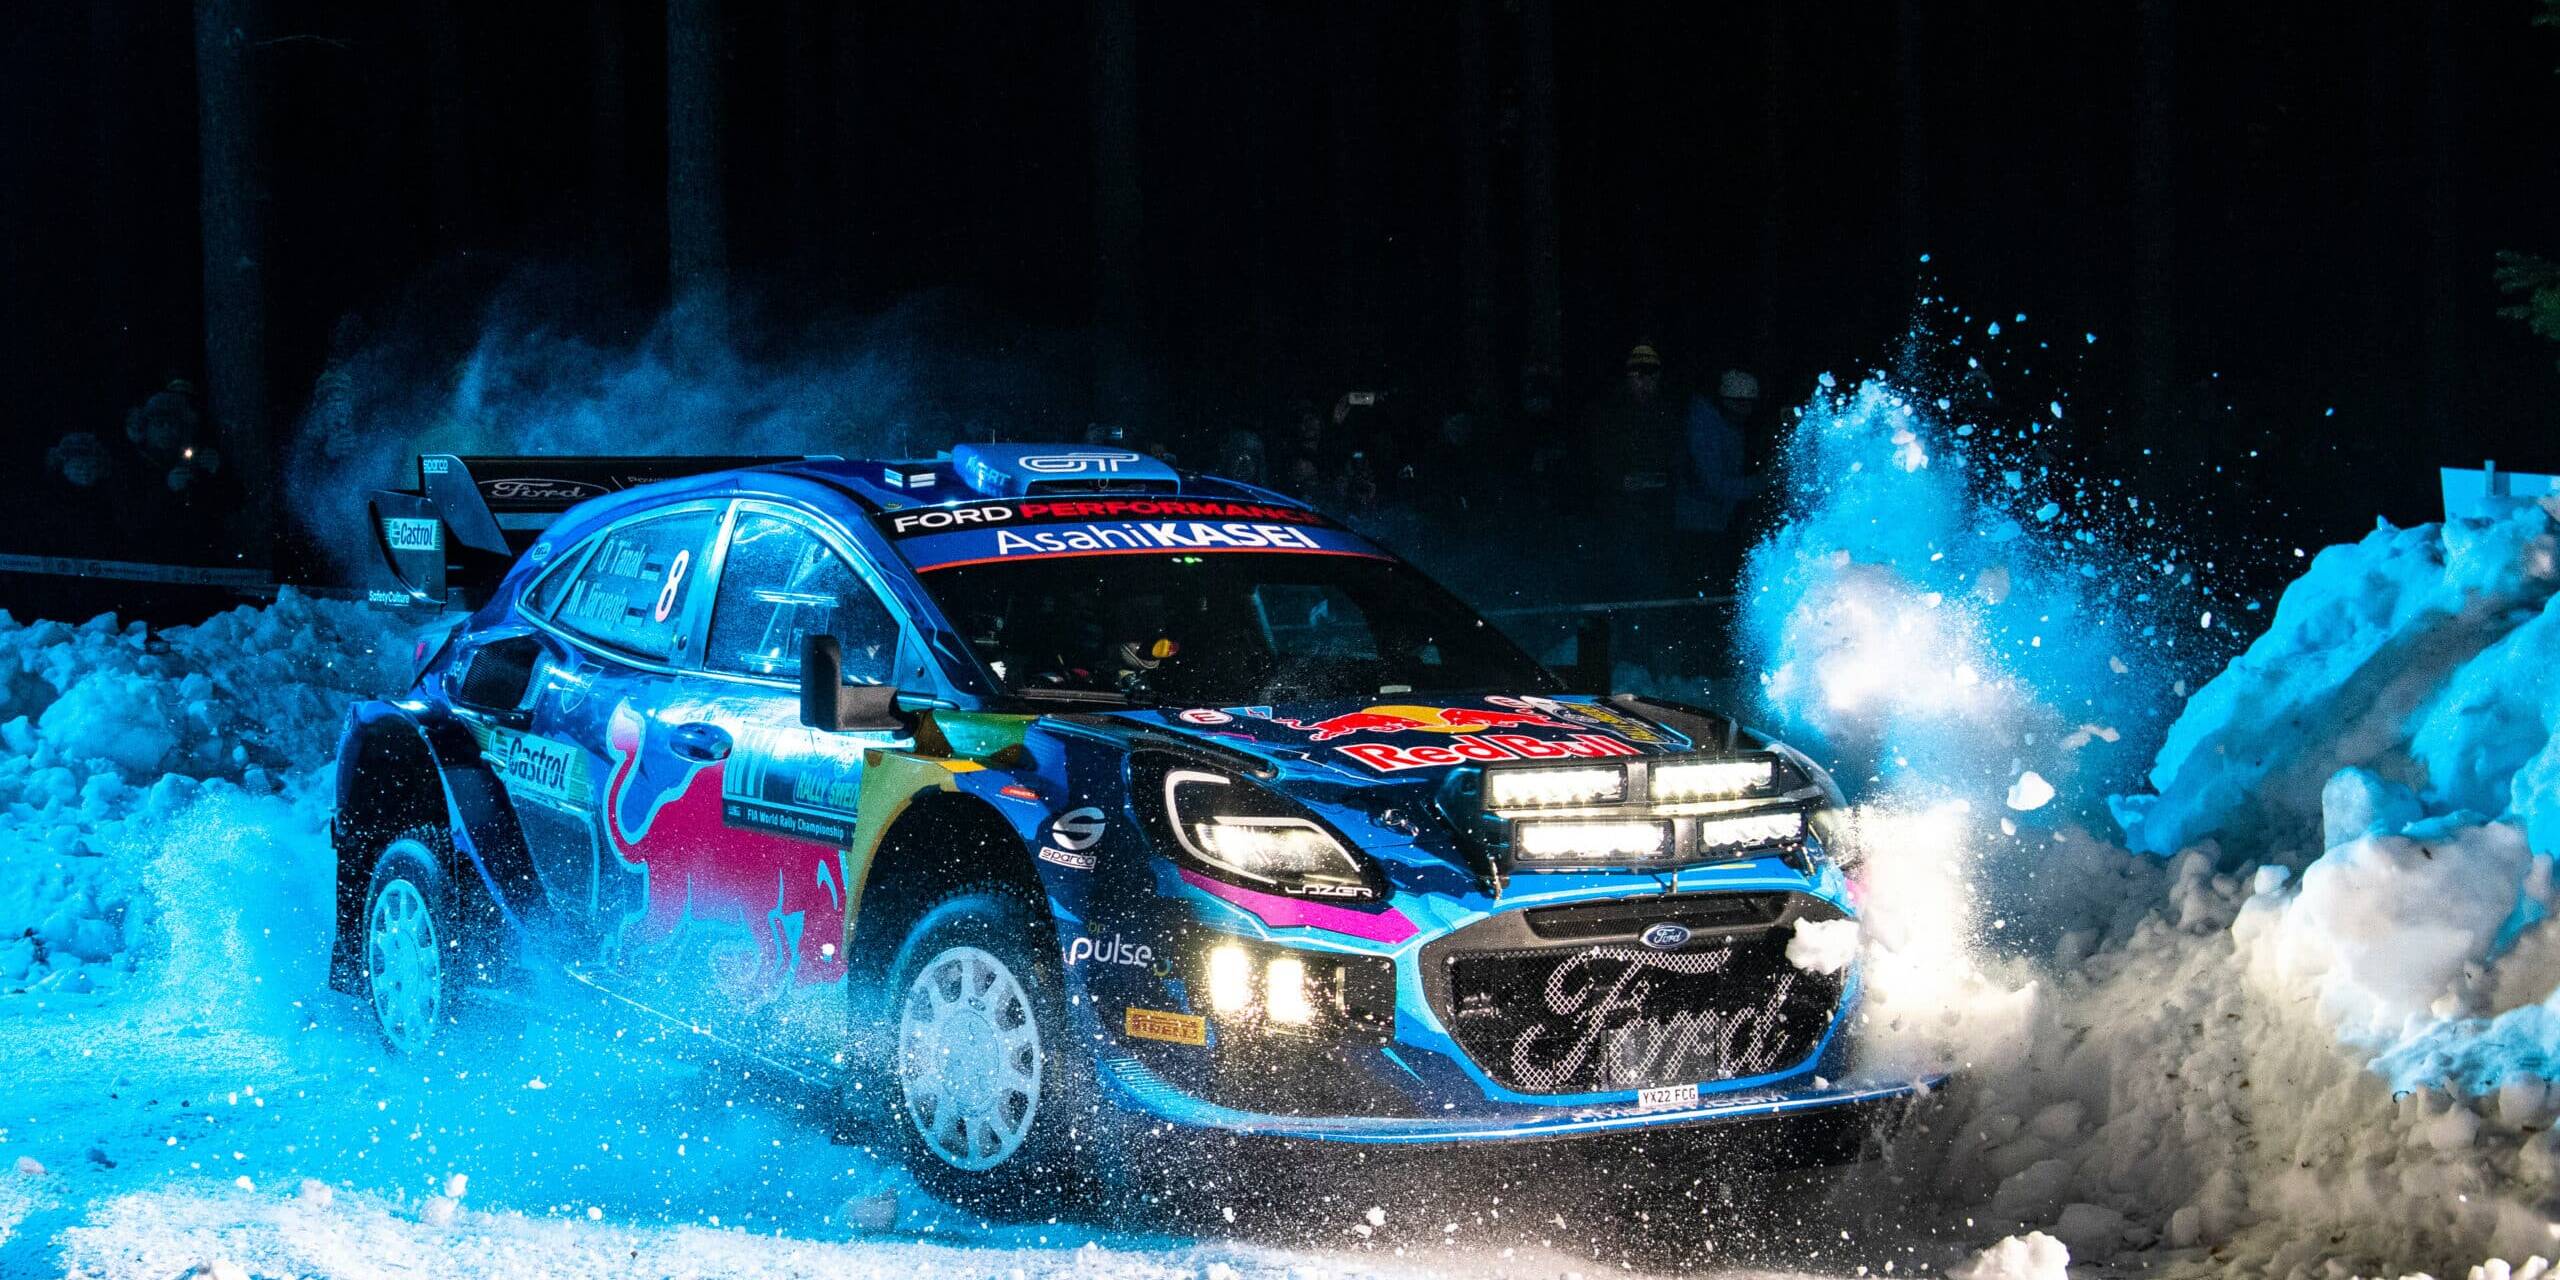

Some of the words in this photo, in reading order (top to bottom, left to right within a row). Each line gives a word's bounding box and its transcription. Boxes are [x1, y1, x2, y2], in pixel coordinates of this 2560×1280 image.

[423, 459, 449, 471] sparco
[491, 481, 586, 498] Ford
[894, 506, 1013, 533] FORD
[1019, 501, 1325, 524] PERFORMANCE
[400, 523, 433, 546] Castrol
[655, 549, 690, 623] 8
[368, 590, 410, 606] SafetyCulture
[508, 736, 570, 791] Castrol
[747, 808, 759, 821] FIA
[760, 811, 779, 826] World
[780, 814, 797, 831] Rally
[798, 818, 844, 841] Championship
[1042, 849, 1095, 866] sparco
[1284, 885, 1373, 898] LAZER
[1653, 927, 1684, 945] Ford
[1062, 933, 1152, 968] pulse
[1511, 947, 1797, 1091] Ford
[1642, 1089, 1671, 1104] YX22
[1675, 1087, 1697, 1101] FCG
